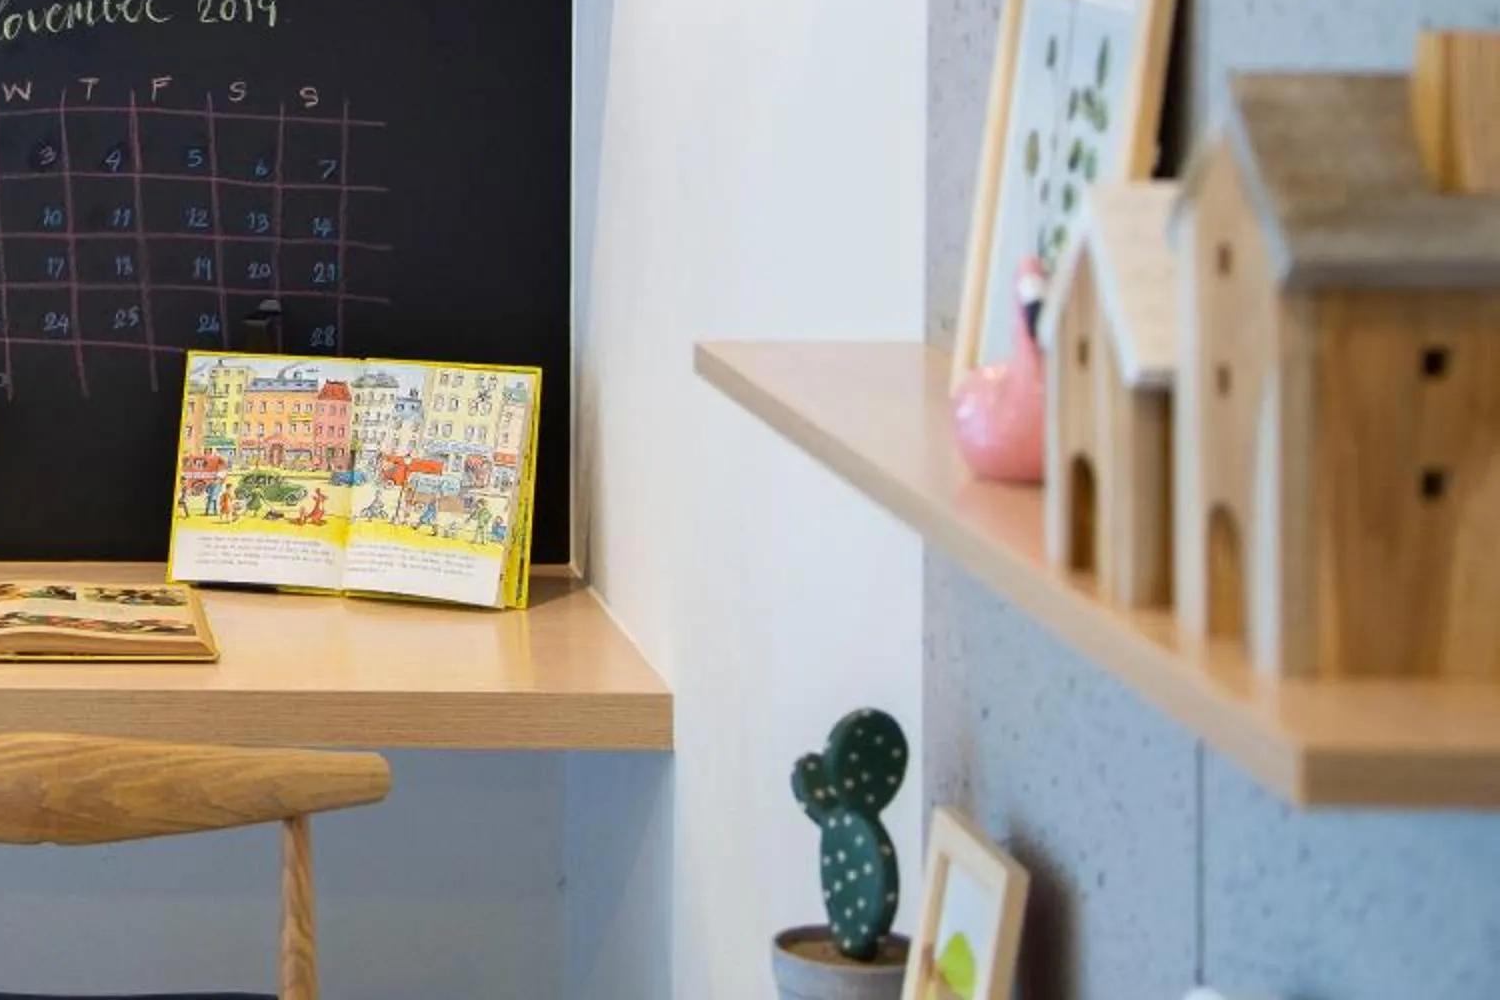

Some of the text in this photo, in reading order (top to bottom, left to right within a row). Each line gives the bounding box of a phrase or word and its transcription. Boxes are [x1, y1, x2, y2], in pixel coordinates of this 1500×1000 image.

[2, 81, 33, 101] W
[78, 77, 100, 100] T
[151, 76, 173, 101] F
[228, 81, 247, 101] S
[300, 86, 319, 108] S
[40, 146, 55, 165] 3
[105, 151, 121, 172] 4
[187, 150, 203, 168] 5
[256, 159, 269, 176] 6
[319, 159, 336, 179] 7
[42, 207, 62, 226] 10
[112, 207, 131, 227] 11
[186, 207, 208, 228] 12
[248, 212, 270, 232] 13
[312, 217, 332, 237] 14
[47, 257, 65, 278] 17
[193, 257, 212, 281] 19
[247, 262, 271, 279] 20
[313, 262, 336, 284] 21
[43, 312, 69, 334] 24
[114, 306, 140, 329] 25
[197, 314, 219, 332] 26
[311, 327, 336, 347] 28
